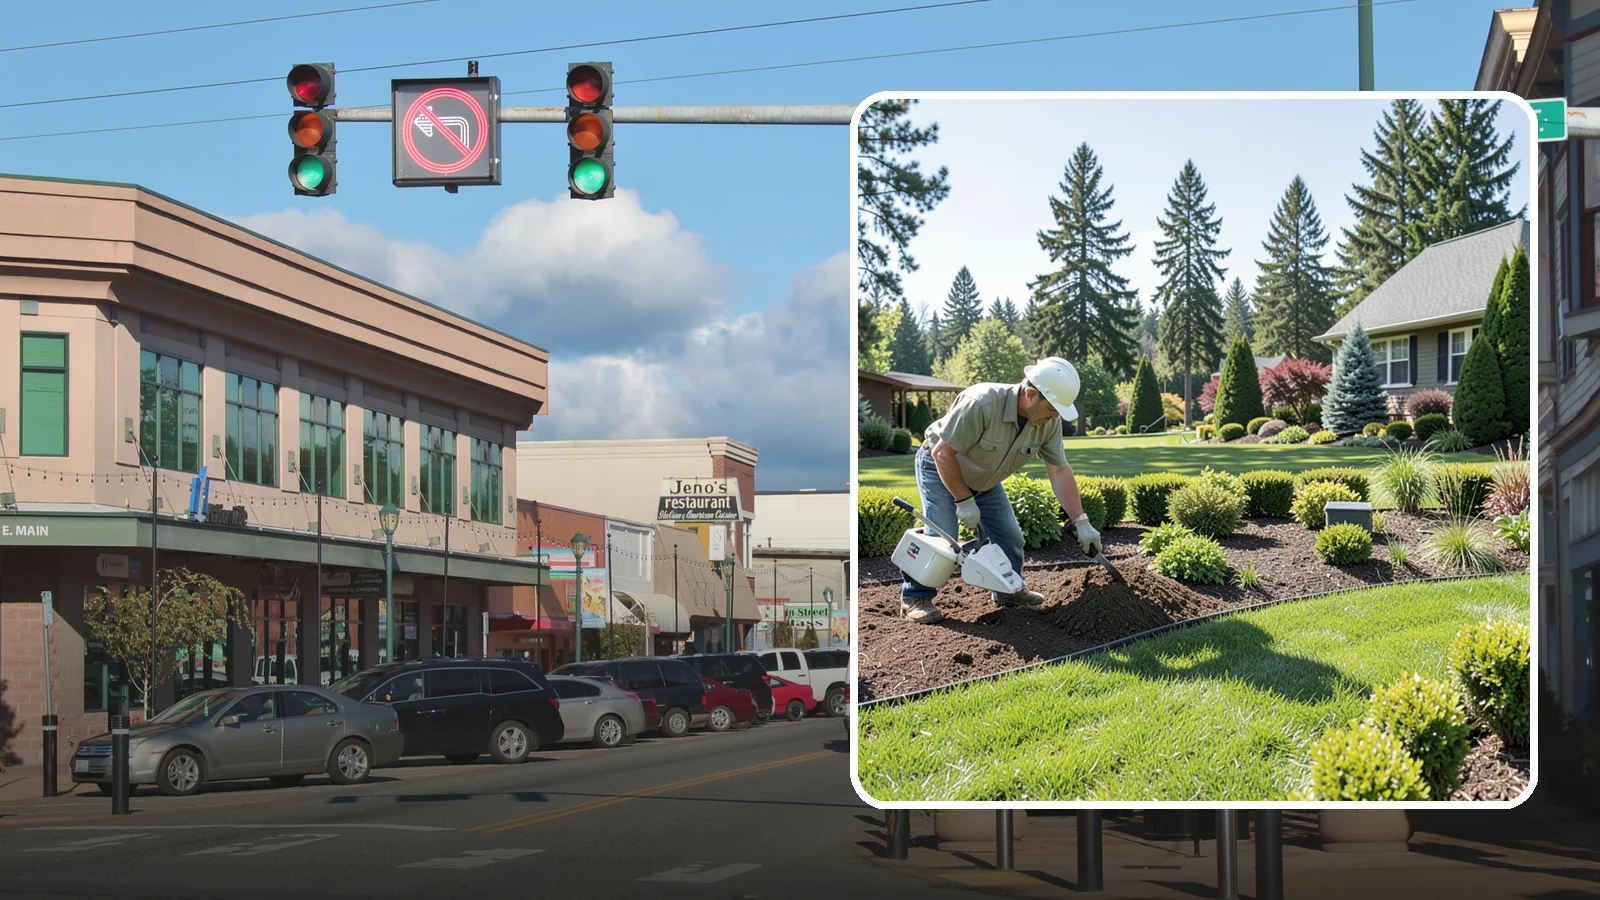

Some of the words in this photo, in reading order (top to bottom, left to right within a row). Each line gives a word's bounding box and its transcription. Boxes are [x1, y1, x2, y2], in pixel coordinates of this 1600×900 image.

[670, 480, 727, 494] Jeno's
[665, 497, 731, 508] restaurant
[659, 510, 681, 519] Italian
[686, 510, 714, 519] American
[715, 510, 738, 519] Cuisine
[2, 525, 13, 536] E.
[15, 525, 49, 536] MAIN
[797, 608, 828, 616] Street
